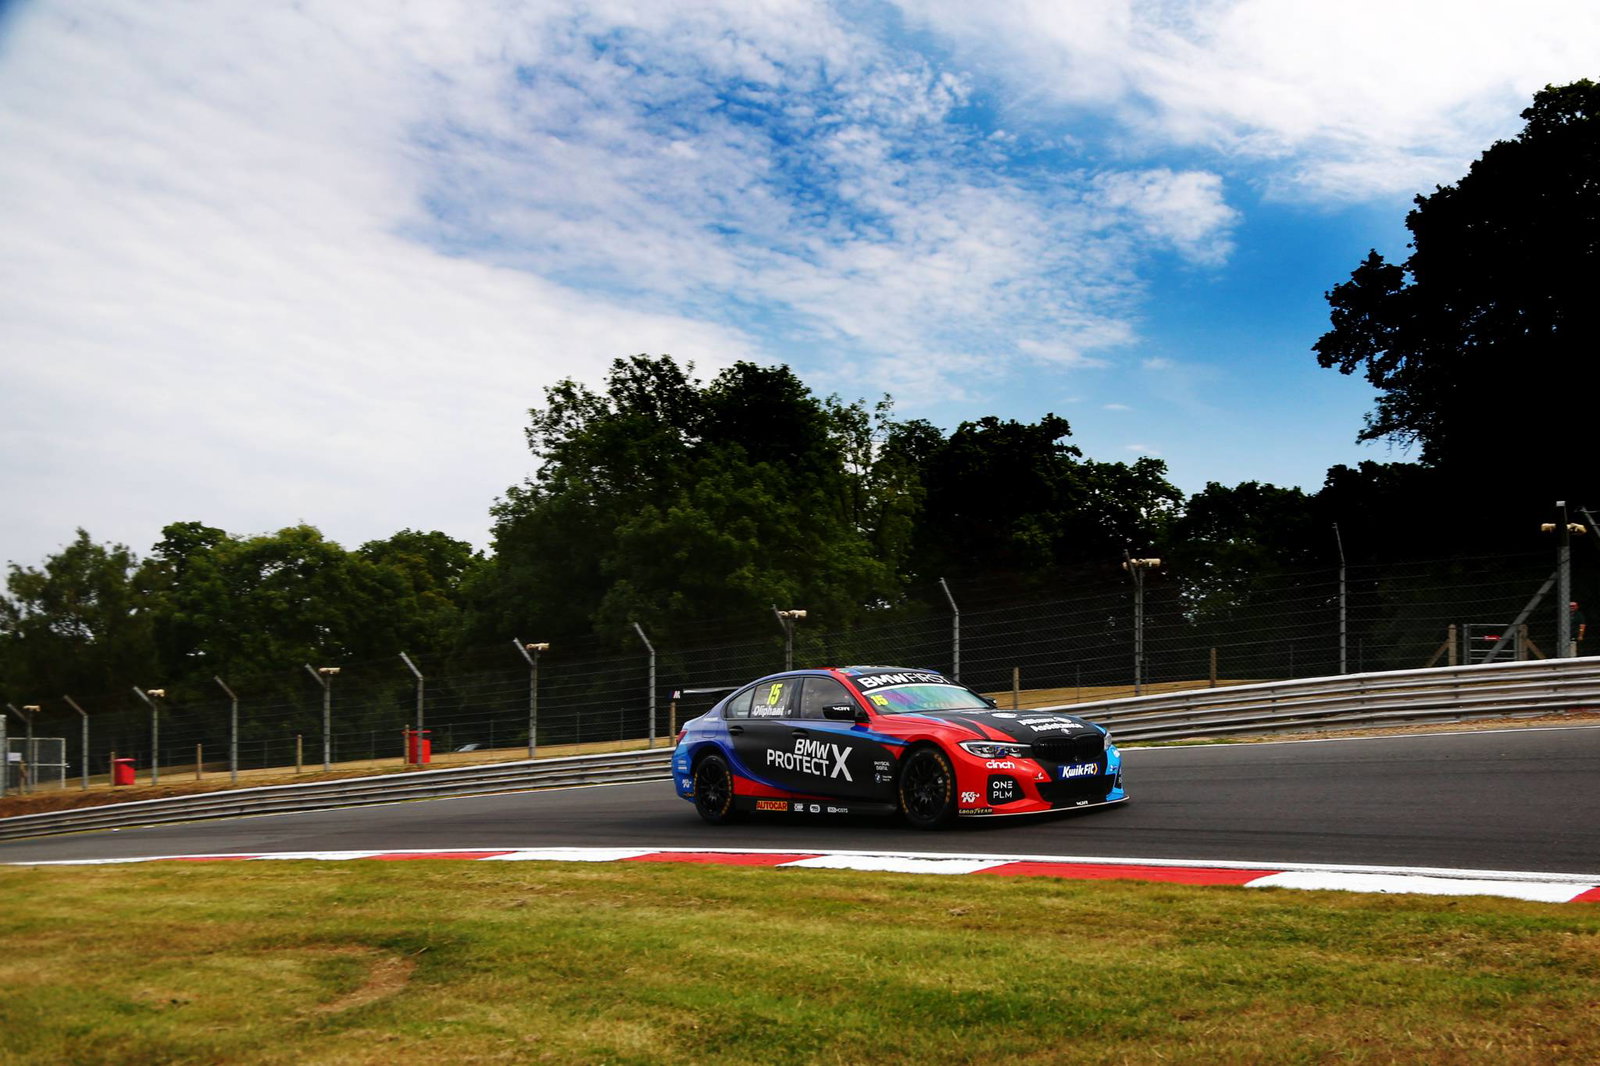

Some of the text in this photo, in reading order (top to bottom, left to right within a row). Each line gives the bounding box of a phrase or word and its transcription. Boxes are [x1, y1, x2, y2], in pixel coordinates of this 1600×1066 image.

[767, 683, 784, 705] 15
[870, 694, 889, 706] 15
[753, 704, 785, 717] Oliphant
[794, 739, 830, 760] BMW
[766, 748, 829, 777] PROTECT
[830, 743, 853, 782] X
[986, 760, 1015, 769] cinch
[993, 781, 1013, 789] ONE
[993, 791, 1013, 799] PLM
[756, 801, 787, 810] AUTOCAR
